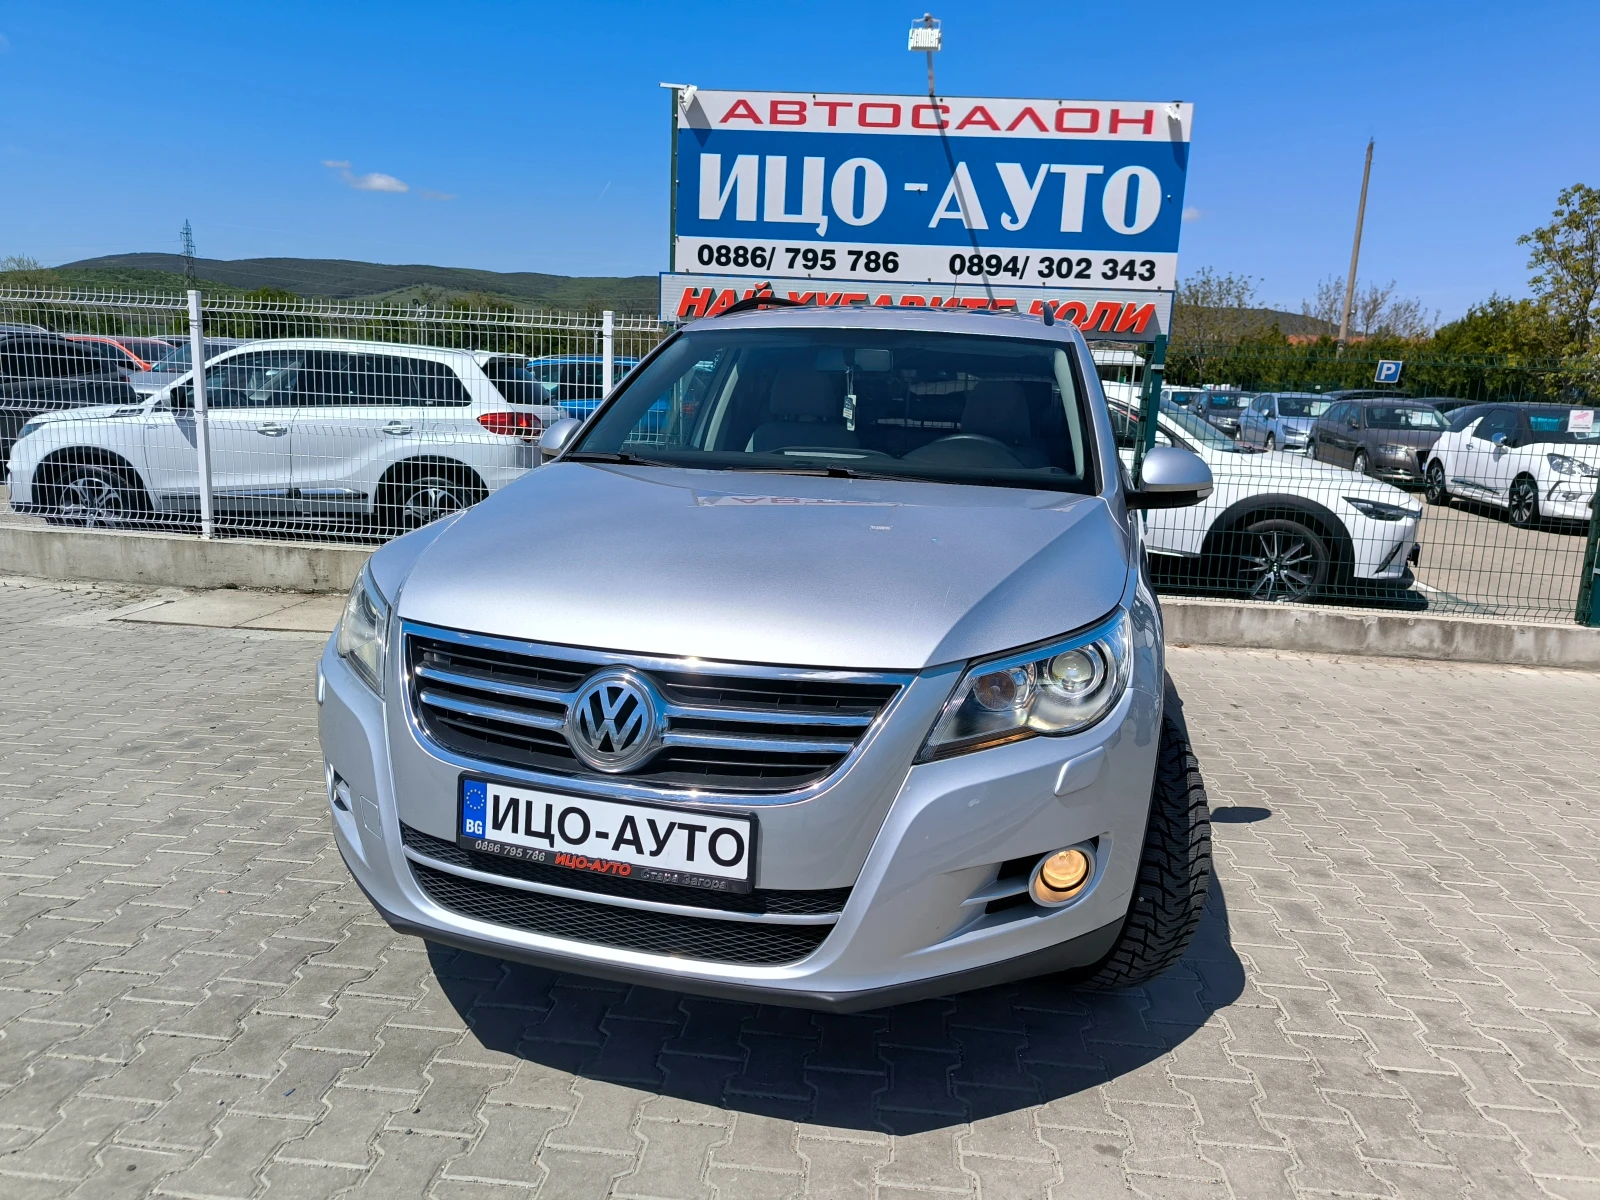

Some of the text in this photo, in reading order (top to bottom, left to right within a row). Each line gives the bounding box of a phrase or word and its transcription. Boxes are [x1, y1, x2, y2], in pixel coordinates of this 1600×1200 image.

[720, 99, 1156, 135] АВТОСАЛОН
[697, 244, 900, 273] 0886/ 795 786
[949, 253, 1156, 282] 0894/ 302 343
[465, 818, 483, 835] BG
[492, 794, 745, 867] ИЦО-АУТО
[475, 840, 546, 862] 0886 795 786
[554, 852, 632, 877] ИЦО-АУТО
[640, 868, 728, 891] Стара Загора
